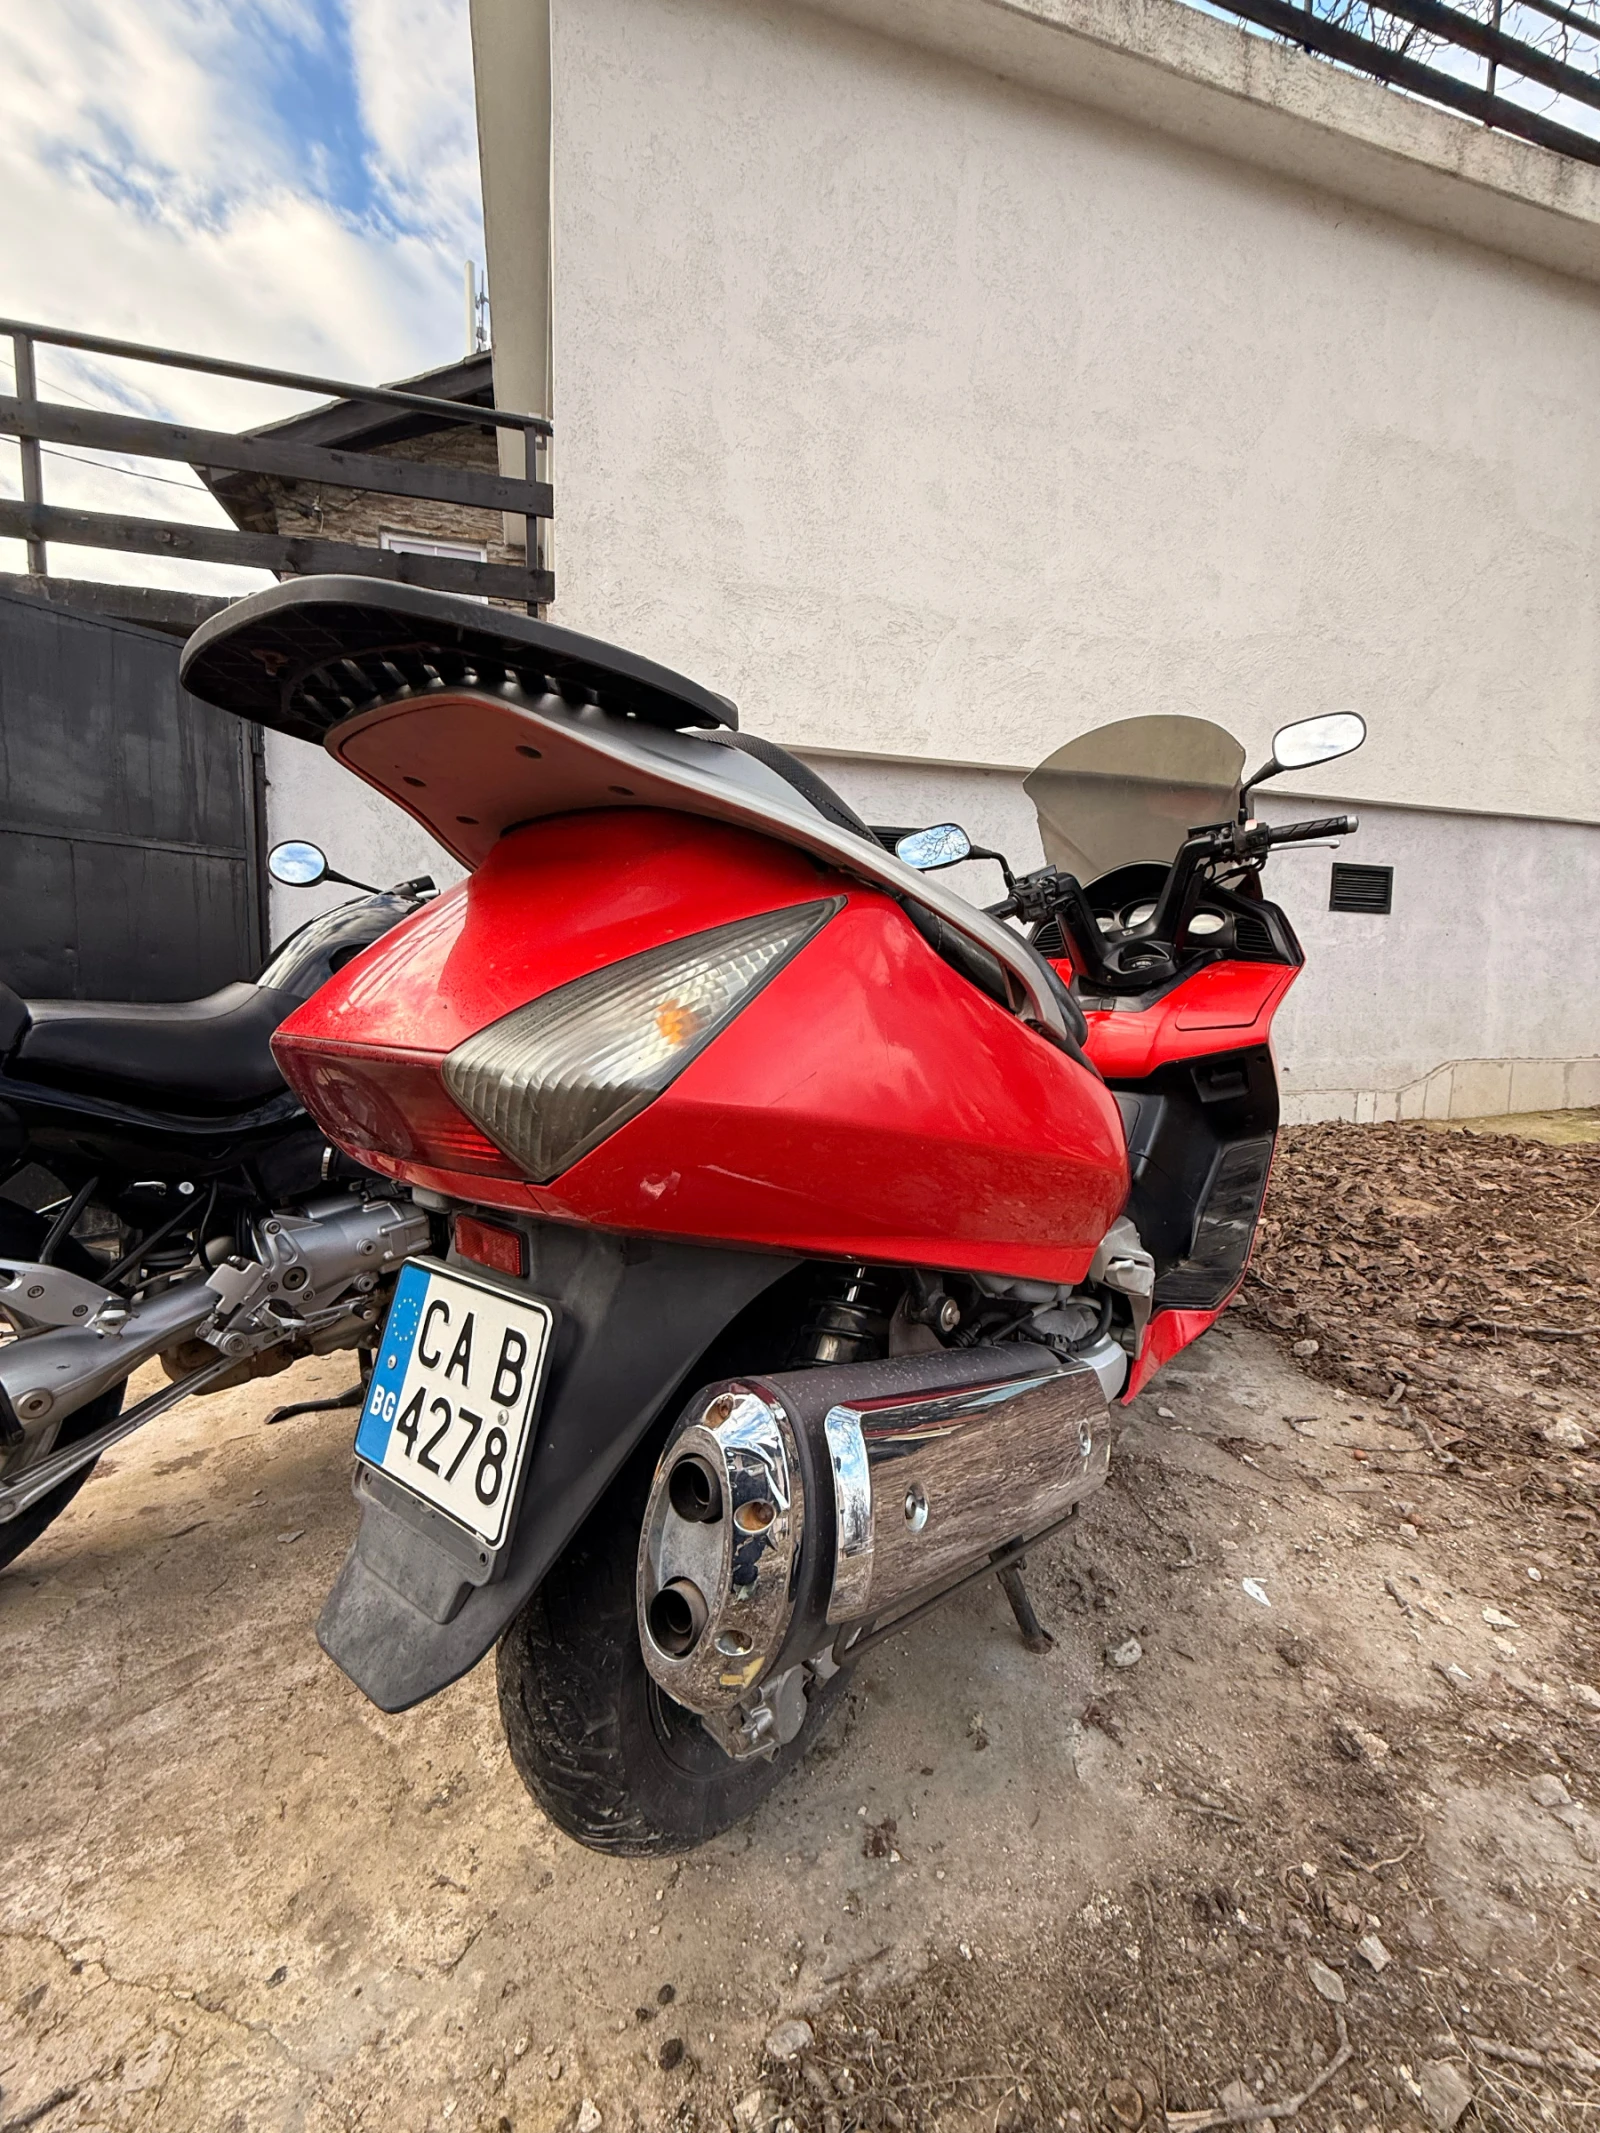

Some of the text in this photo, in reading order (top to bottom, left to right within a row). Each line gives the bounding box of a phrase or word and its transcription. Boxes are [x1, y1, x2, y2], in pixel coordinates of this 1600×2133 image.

[369, 1383, 396, 1423] BG
[418, 1299, 528, 1407] CA B
[396, 1386, 508, 1506] 4278
